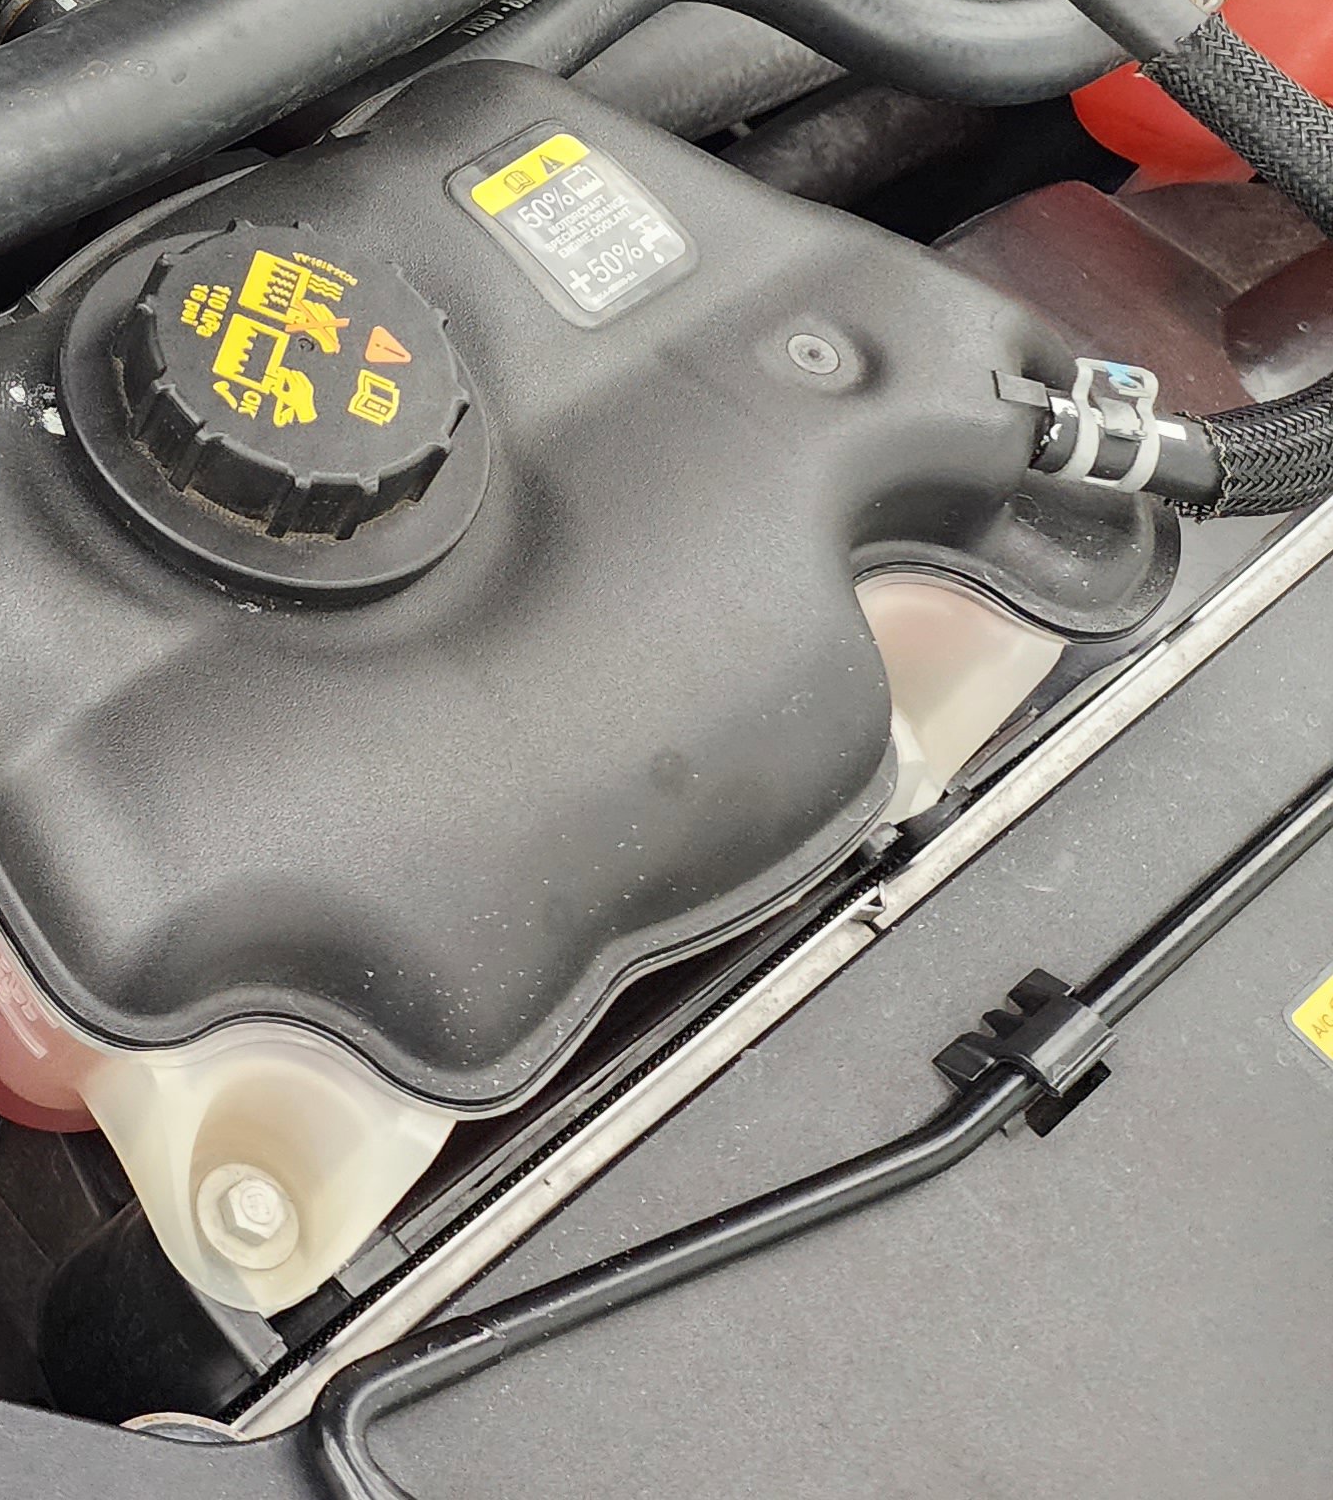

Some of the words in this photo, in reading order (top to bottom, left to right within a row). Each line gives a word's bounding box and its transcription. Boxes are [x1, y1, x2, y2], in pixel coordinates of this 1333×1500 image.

[517, 187, 575, 228] 50%
[548, 194, 607, 237] MOTORCRAFT
[544, 221, 593, 253] SPECIALTY
[589, 194, 630, 223] ORANGE
[557, 232, 594, 259] ENGINE
[590, 205, 633, 238] COOLANT
[190, 284, 210, 303] 16
[207, 284, 232, 311] 110
[181, 299, 201, 327] psi
[196, 308, 225, 338] kPa
[238, 390, 263, 420] OK
